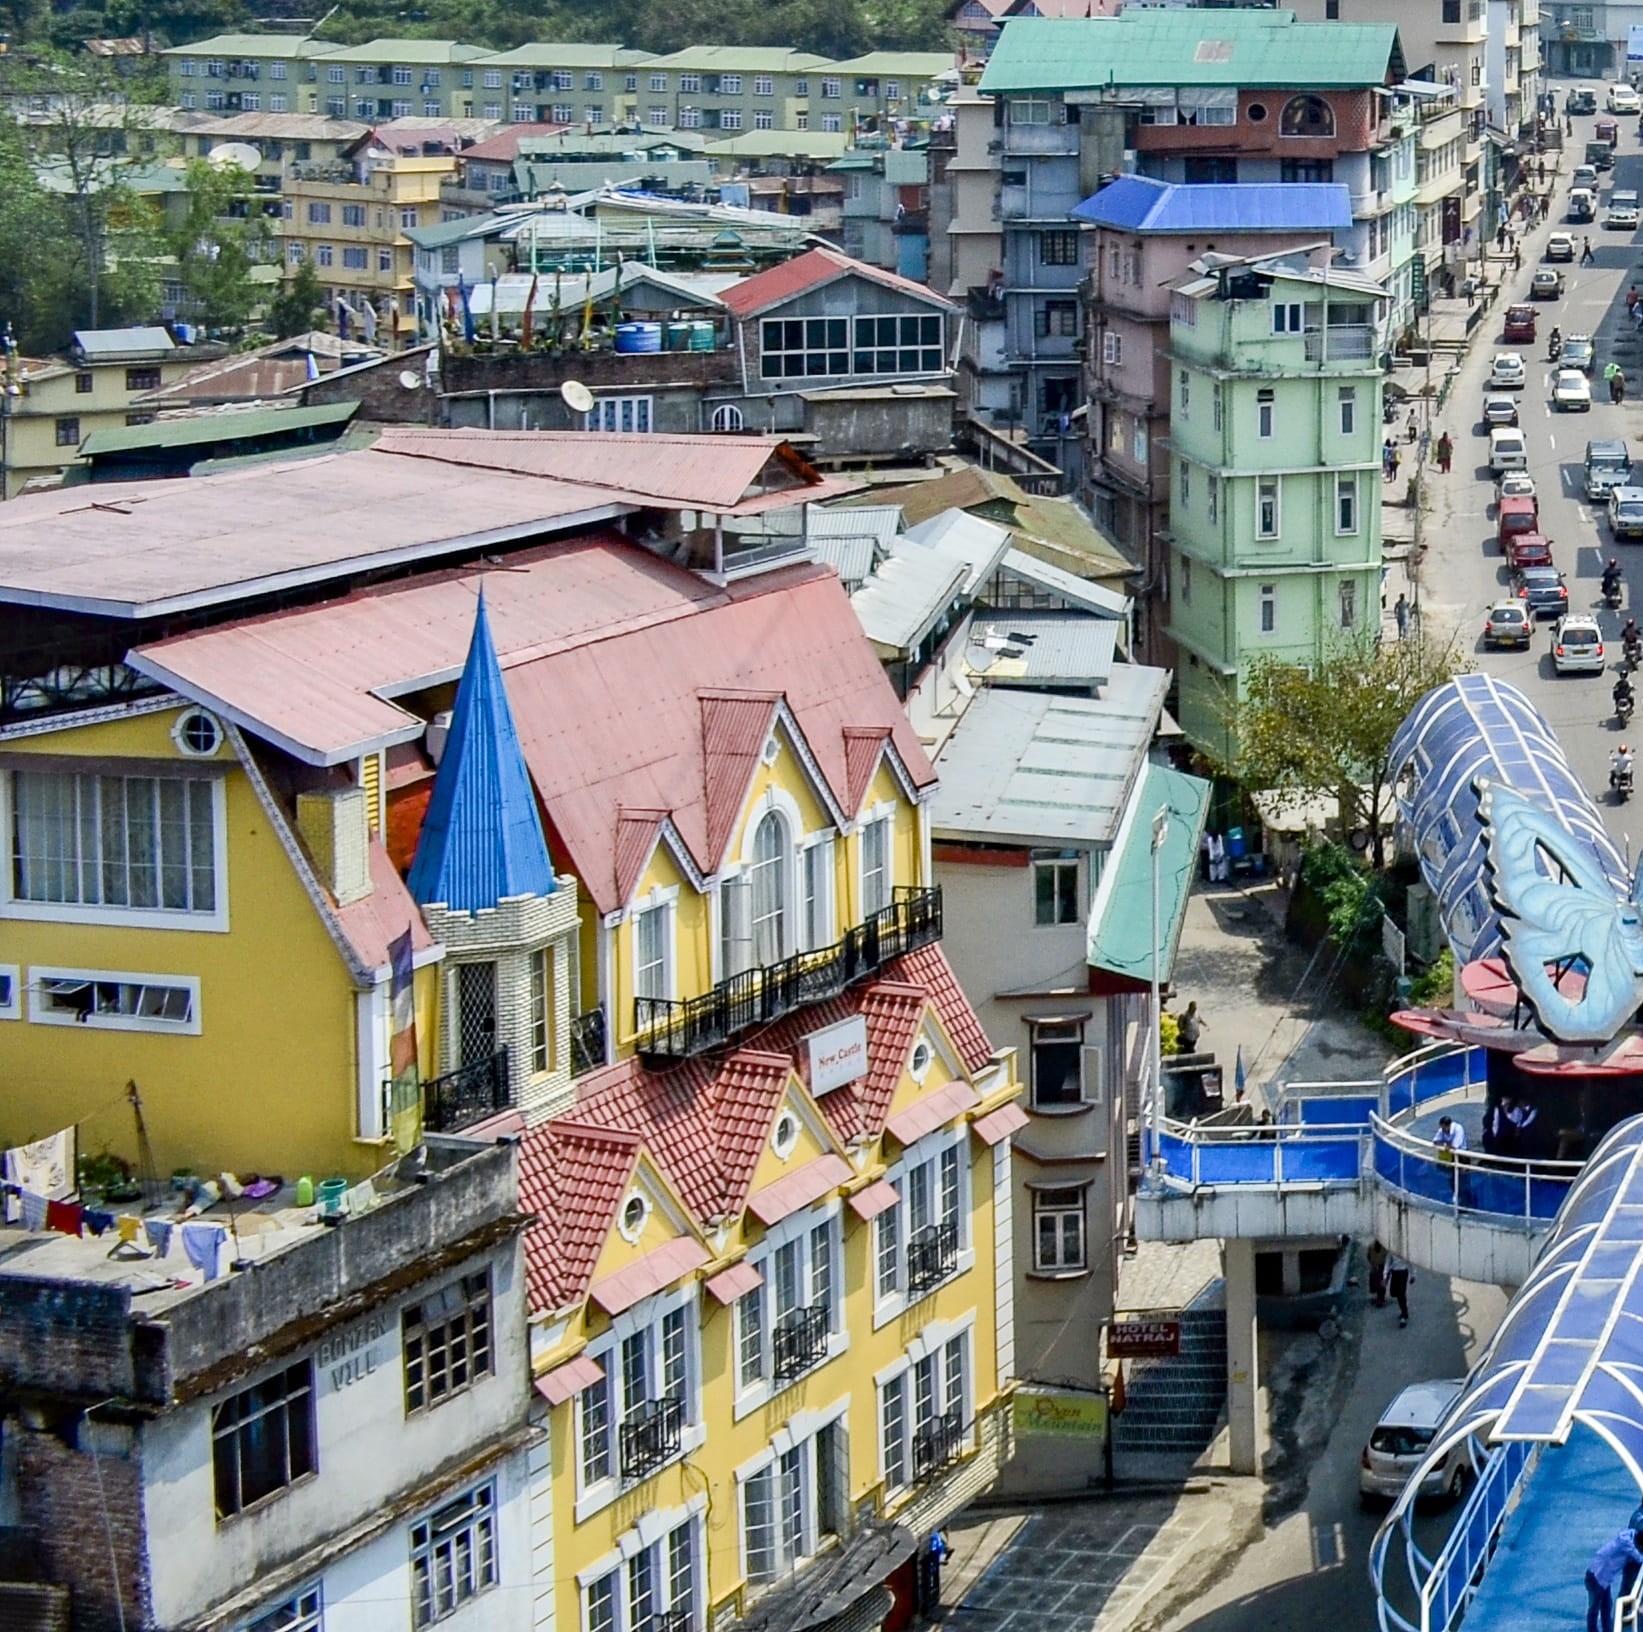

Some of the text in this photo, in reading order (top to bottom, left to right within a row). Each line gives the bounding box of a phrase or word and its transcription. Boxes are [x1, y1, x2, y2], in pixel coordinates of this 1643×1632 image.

[818, 1053, 837, 1067] New
[838, 1043, 861, 1059] Castle
[1115, 1323, 1169, 1334] HOTEL
[1110, 1332, 1175, 1344] NATRAJ
[332, 1351, 377, 1391] VILL
